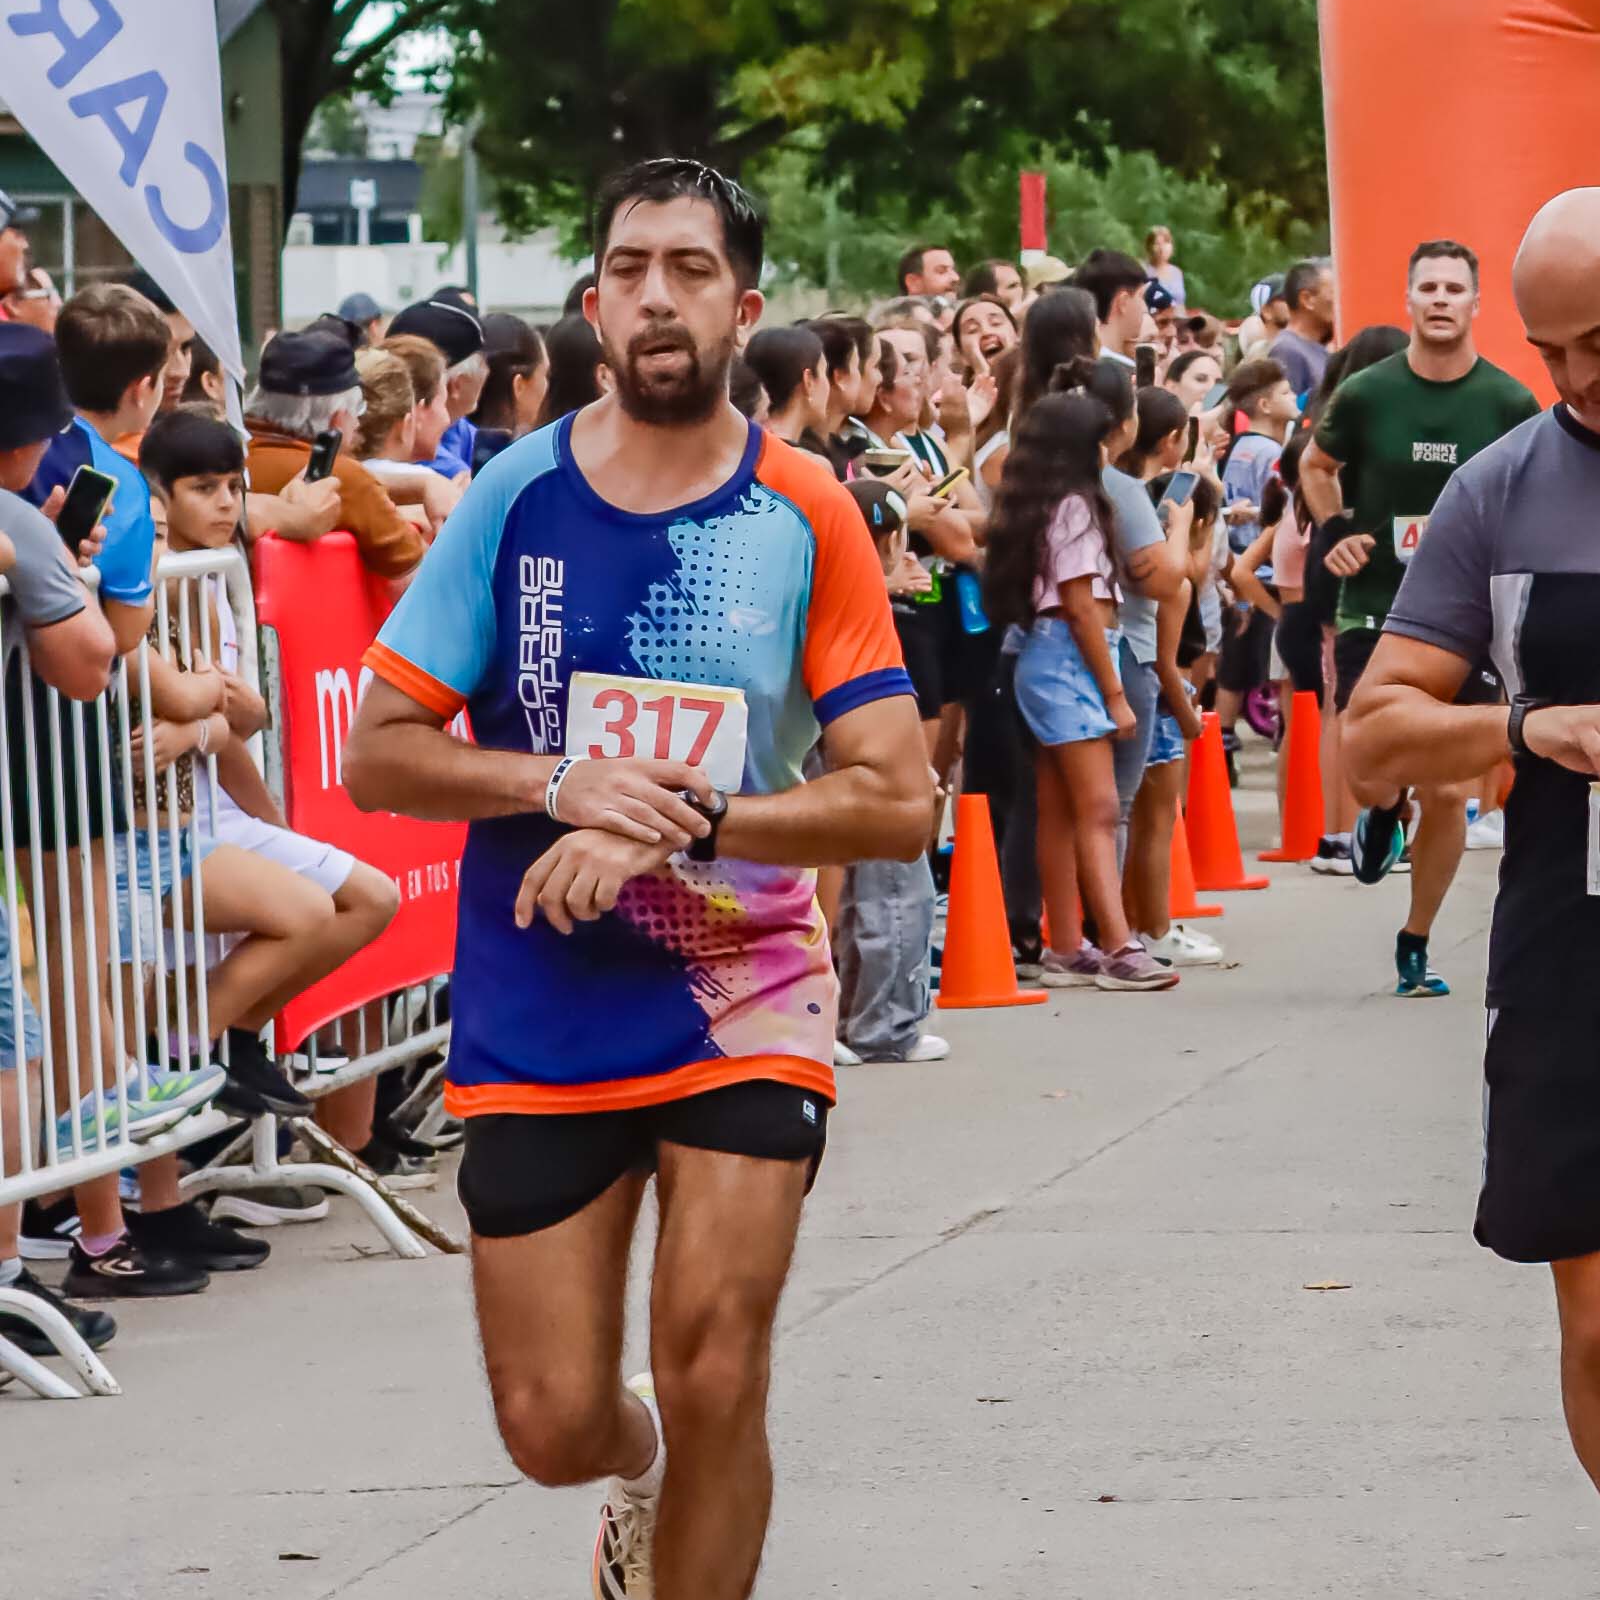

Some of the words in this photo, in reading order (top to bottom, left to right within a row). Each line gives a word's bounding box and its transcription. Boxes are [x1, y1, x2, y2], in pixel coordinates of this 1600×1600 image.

[1412, 441, 1457, 453] MONKY
[588, 688, 725, 768] 317
[426, 860, 450, 893] TUS
